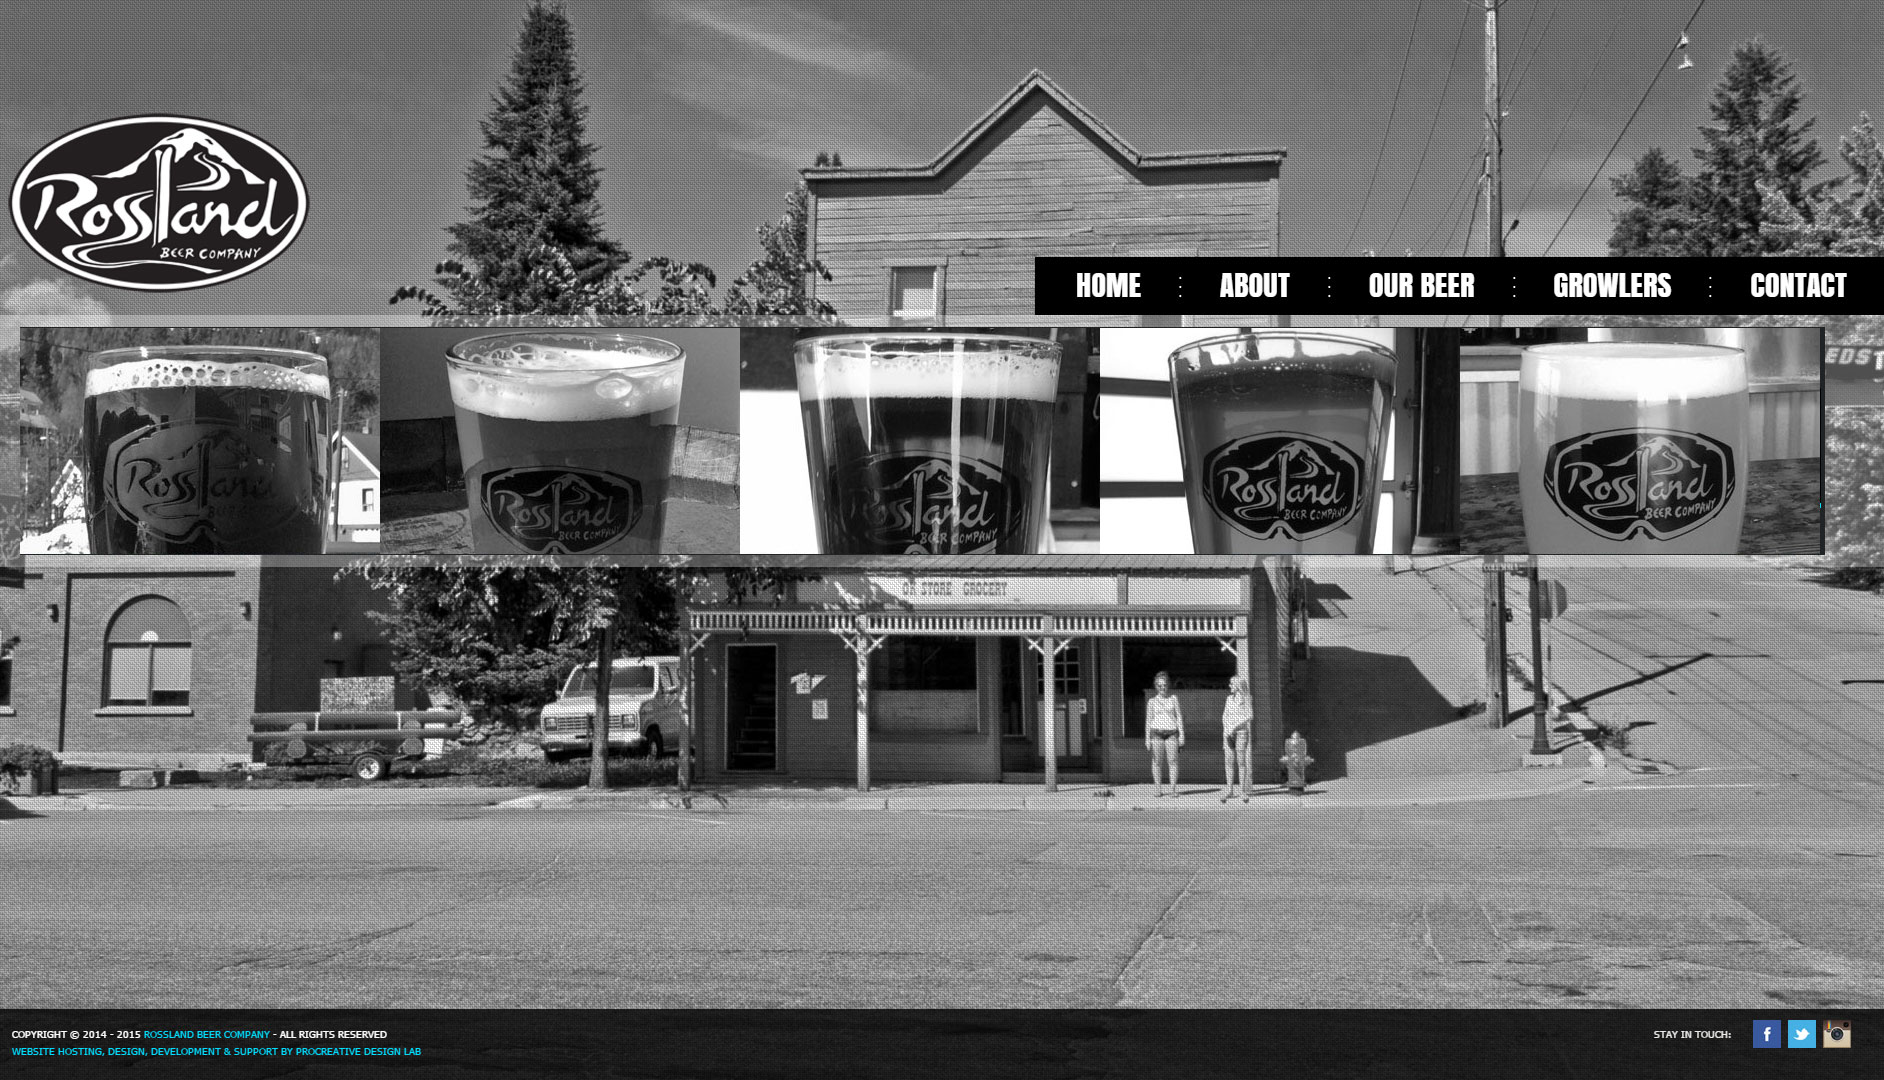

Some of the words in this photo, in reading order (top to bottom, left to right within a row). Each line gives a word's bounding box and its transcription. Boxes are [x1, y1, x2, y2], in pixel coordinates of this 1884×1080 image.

[1217, 452, 1345, 511] Rossland
[1564, 448, 1713, 511] Rossland
[494, 483, 620, 533] Rossland
[1284, 508, 1307, 520] BEER
[1310, 506, 1347, 521] COMPANY
[1644, 506, 1672, 520] BEER
[1675, 498, 1717, 518] COMPANY
[557, 531, 581, 541] BEER
[951, 528, 998, 545] COMPANY
[921, 581, 952, 596] STORE
[963, 581, 1008, 596] GROCERY
